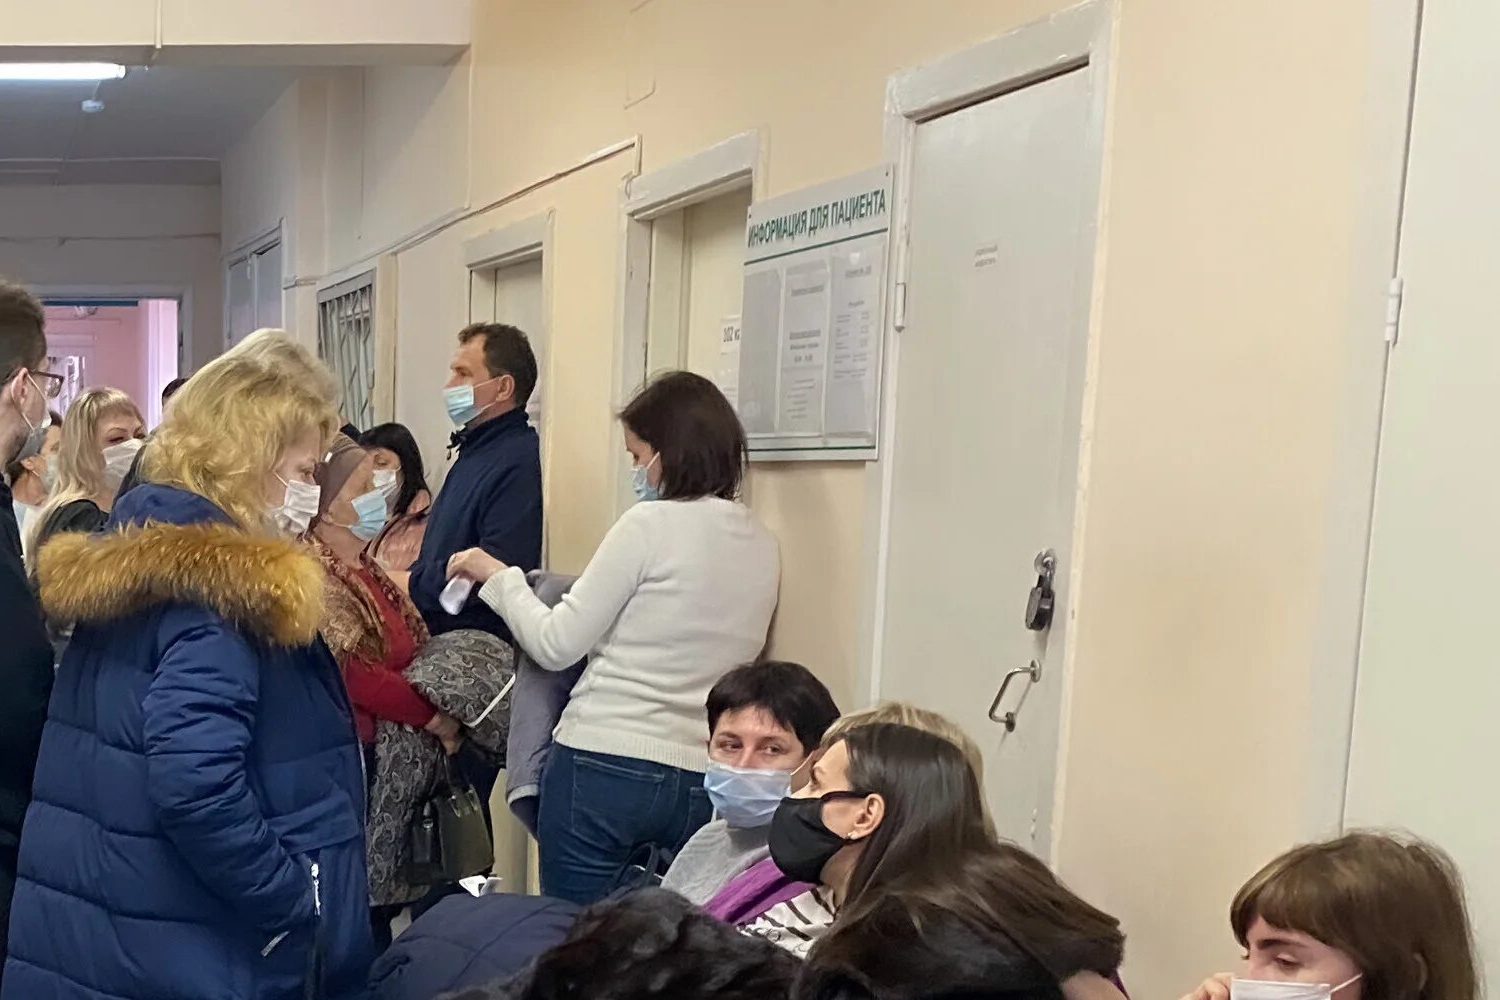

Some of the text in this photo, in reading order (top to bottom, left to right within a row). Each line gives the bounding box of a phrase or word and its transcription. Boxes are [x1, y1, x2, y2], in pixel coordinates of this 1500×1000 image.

[747, 189, 886, 248] ИНФОРМАЦИЯ ДЛЯ ПАЦИЕНТА
